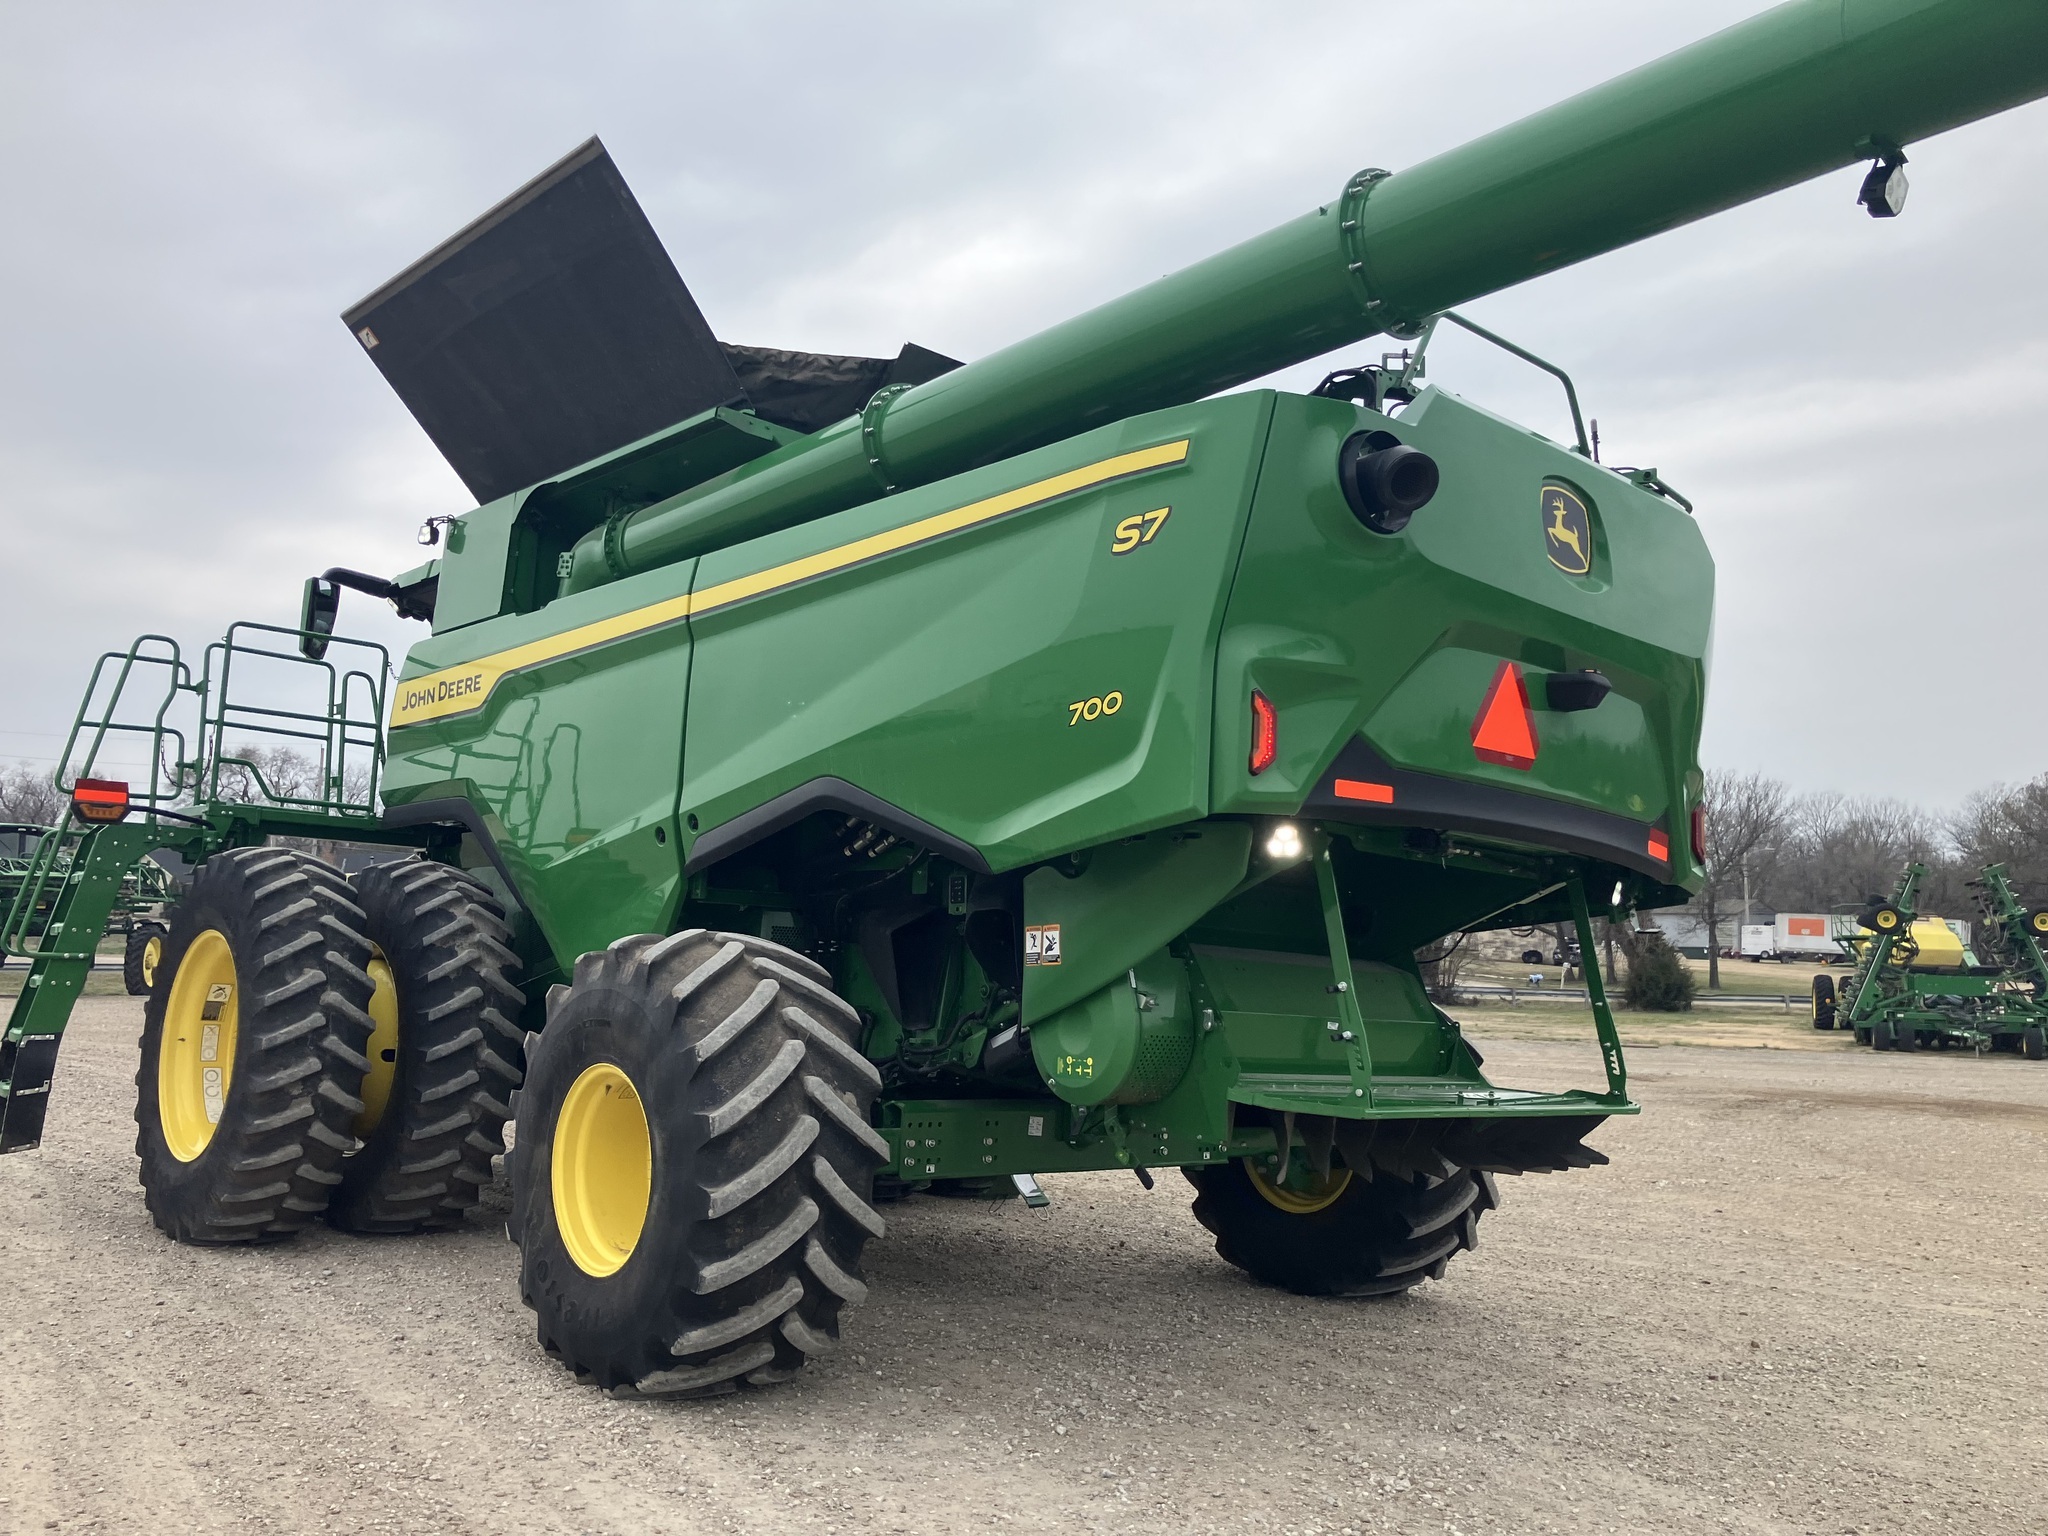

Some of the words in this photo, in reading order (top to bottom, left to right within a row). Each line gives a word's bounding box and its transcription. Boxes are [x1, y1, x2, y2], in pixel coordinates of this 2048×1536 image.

[1111, 505, 1172, 556] S7
[402, 687, 436, 711] JOHN
[438, 674, 482, 702] DEERE
[1068, 690, 1123, 727] 700
